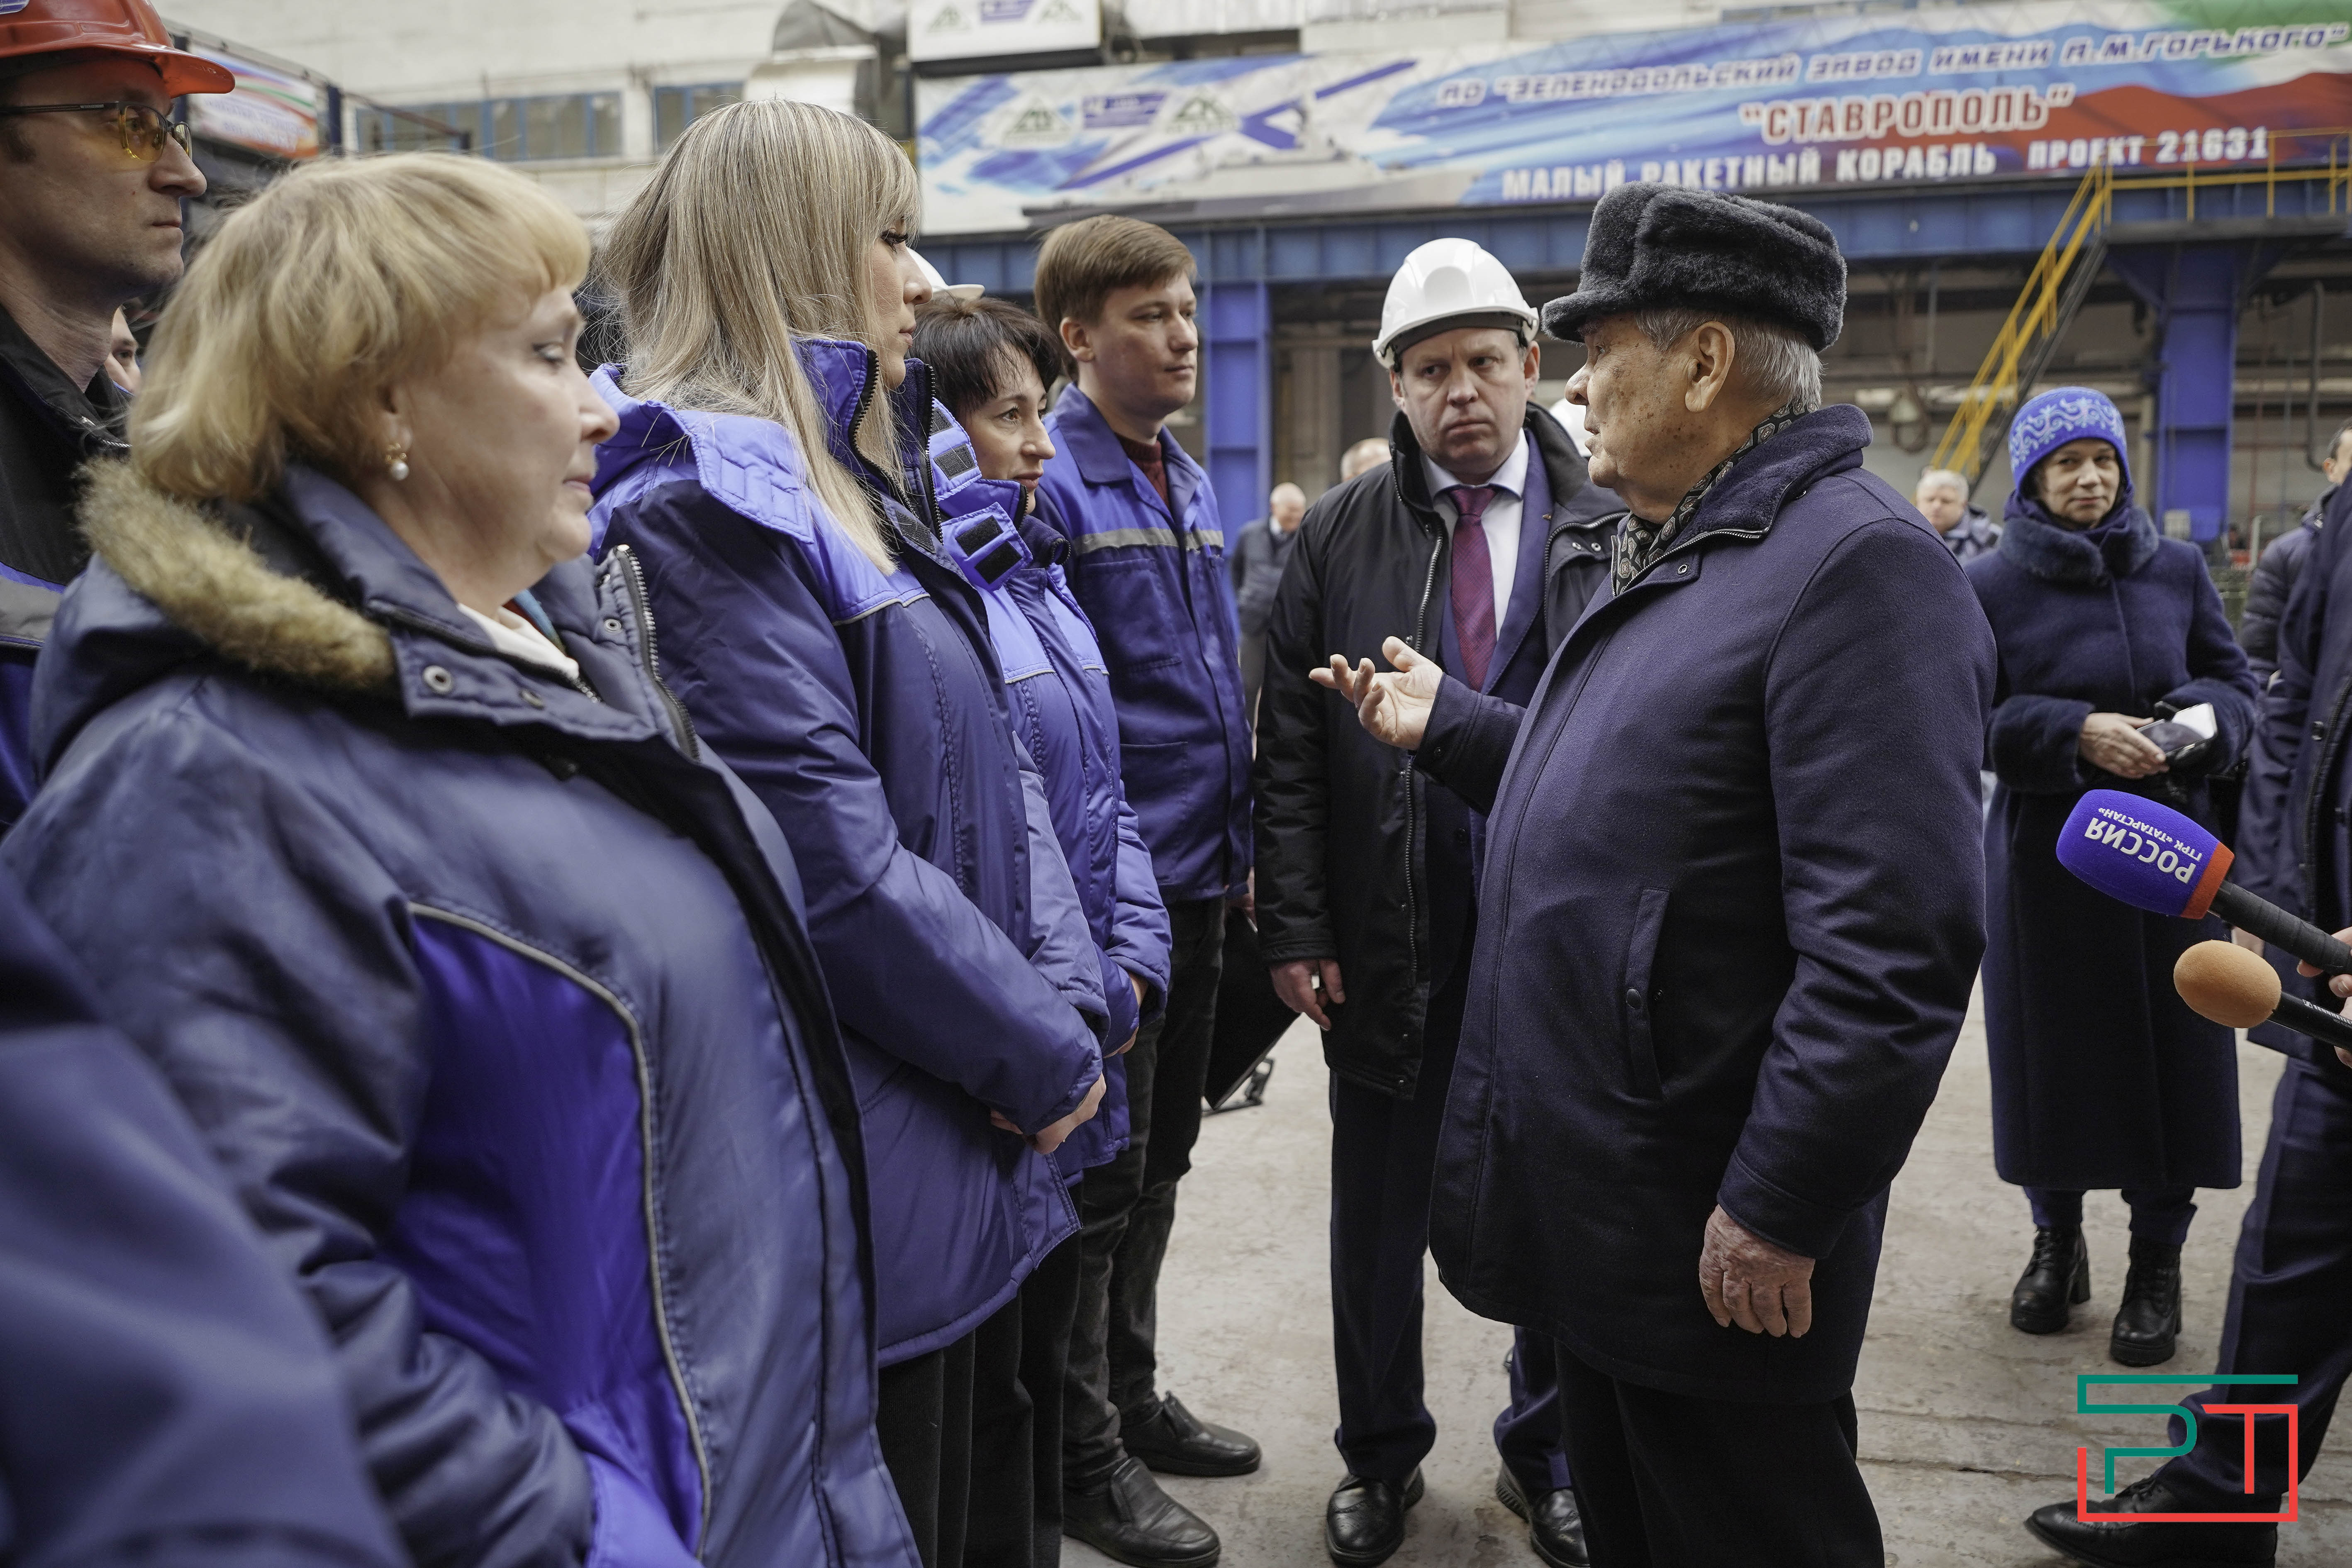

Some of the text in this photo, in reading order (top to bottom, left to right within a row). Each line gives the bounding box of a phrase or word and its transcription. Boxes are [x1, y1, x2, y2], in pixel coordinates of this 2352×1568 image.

[1808, 51, 1920, 80] ЗАВОД
[1930, 41, 2052, 72] ИМЕНИ
[1502, 126, 2268, 200] МАЛЫЙ РАКЕТНЫЙ КОРАБЛЬ ПРОЕКТ 21631
[2084, 817, 2196, 884] РОССИЯ
[2098, 807, 2202, 861] ГТРК «ТАТАРСТАН»
